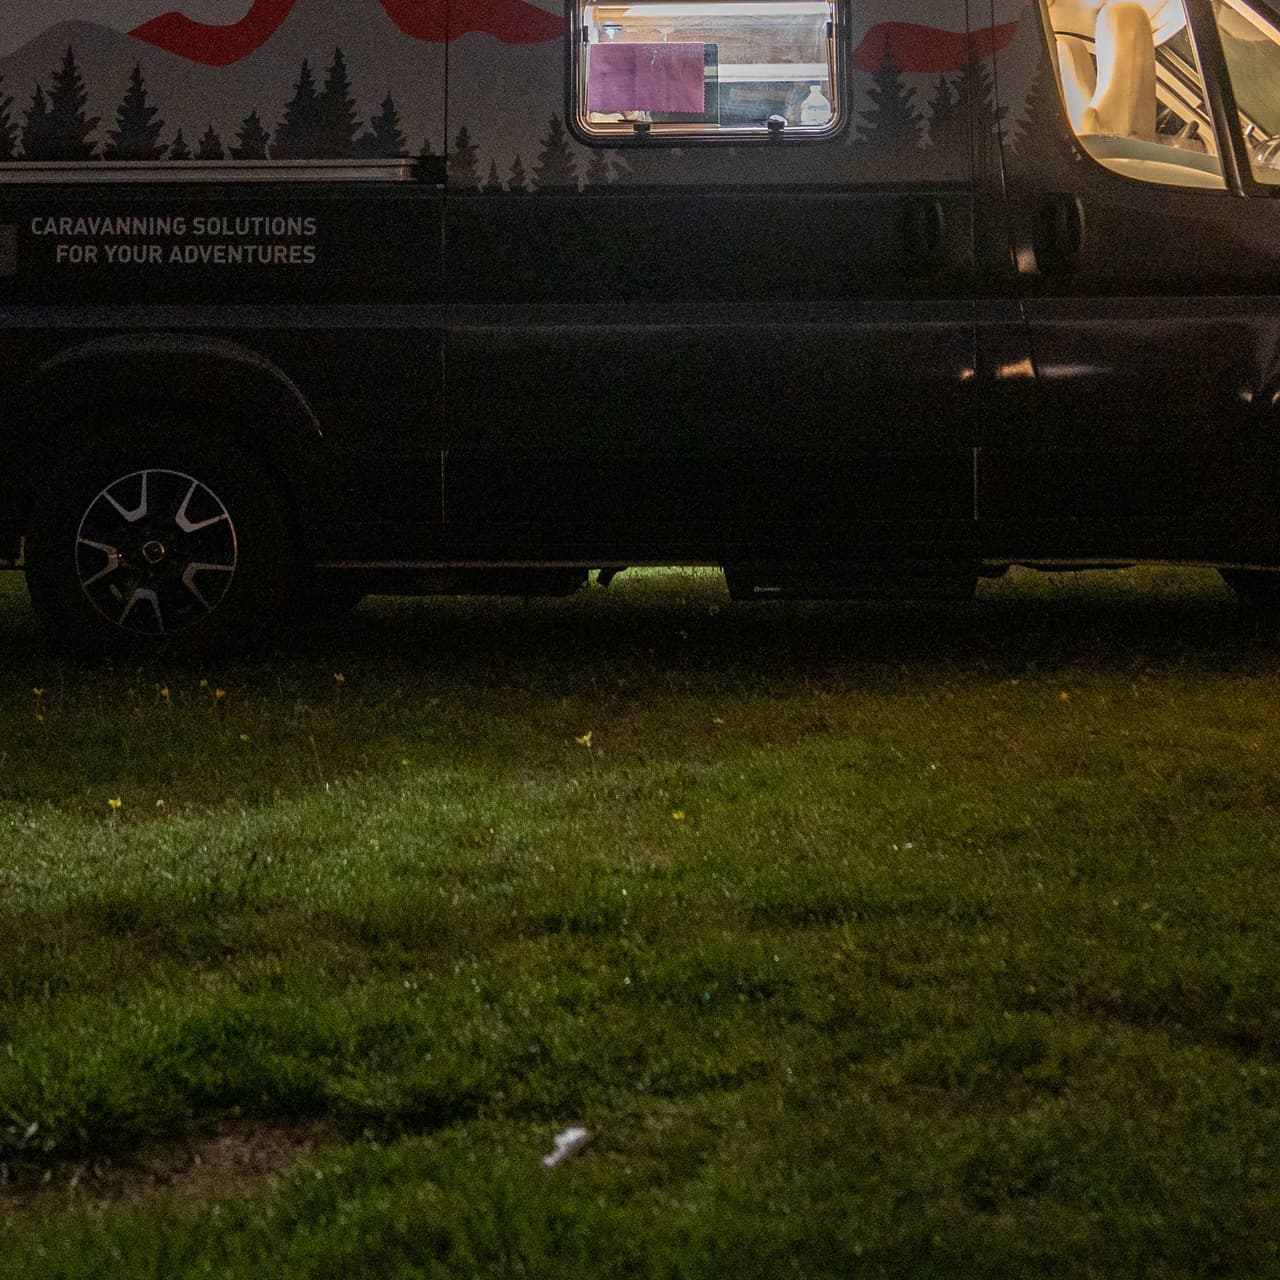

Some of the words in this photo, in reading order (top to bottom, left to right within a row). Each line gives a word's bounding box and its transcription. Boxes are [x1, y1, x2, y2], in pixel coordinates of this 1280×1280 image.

[31, 216, 187, 236] CARAVANNING
[193, 216, 317, 236] SOLUTIONS
[56, 244, 99, 264] FOR
[104, 244, 163, 264] YOUR
[169, 244, 317, 264] ADVENTURES
